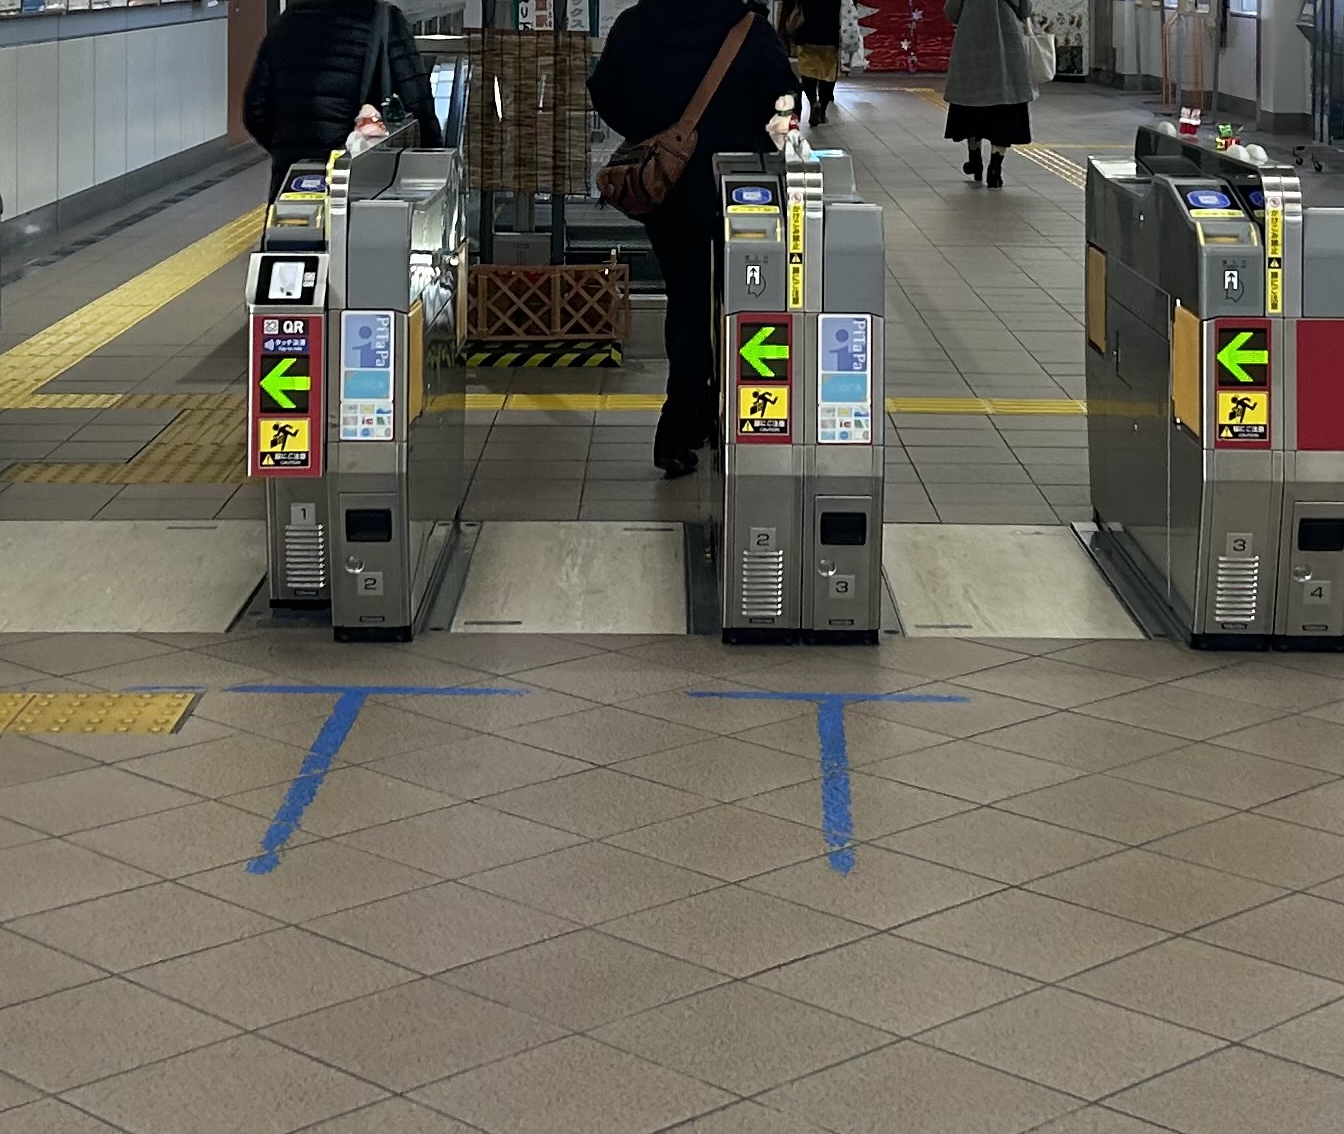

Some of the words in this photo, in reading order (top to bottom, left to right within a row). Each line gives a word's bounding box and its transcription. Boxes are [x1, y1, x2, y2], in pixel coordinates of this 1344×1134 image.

[282, 320, 304, 334] QR
[375, 317, 390, 367] PiTaPa
[852, 320, 867, 371] PiTaPa
[299, 507, 306, 521] 1
[756, 533, 770, 546] 2
[1232, 539, 1247, 552] 3
[363, 577, 377, 591] 2
[835, 580, 849, 593] 3
[1309, 586, 1325, 599] 4
